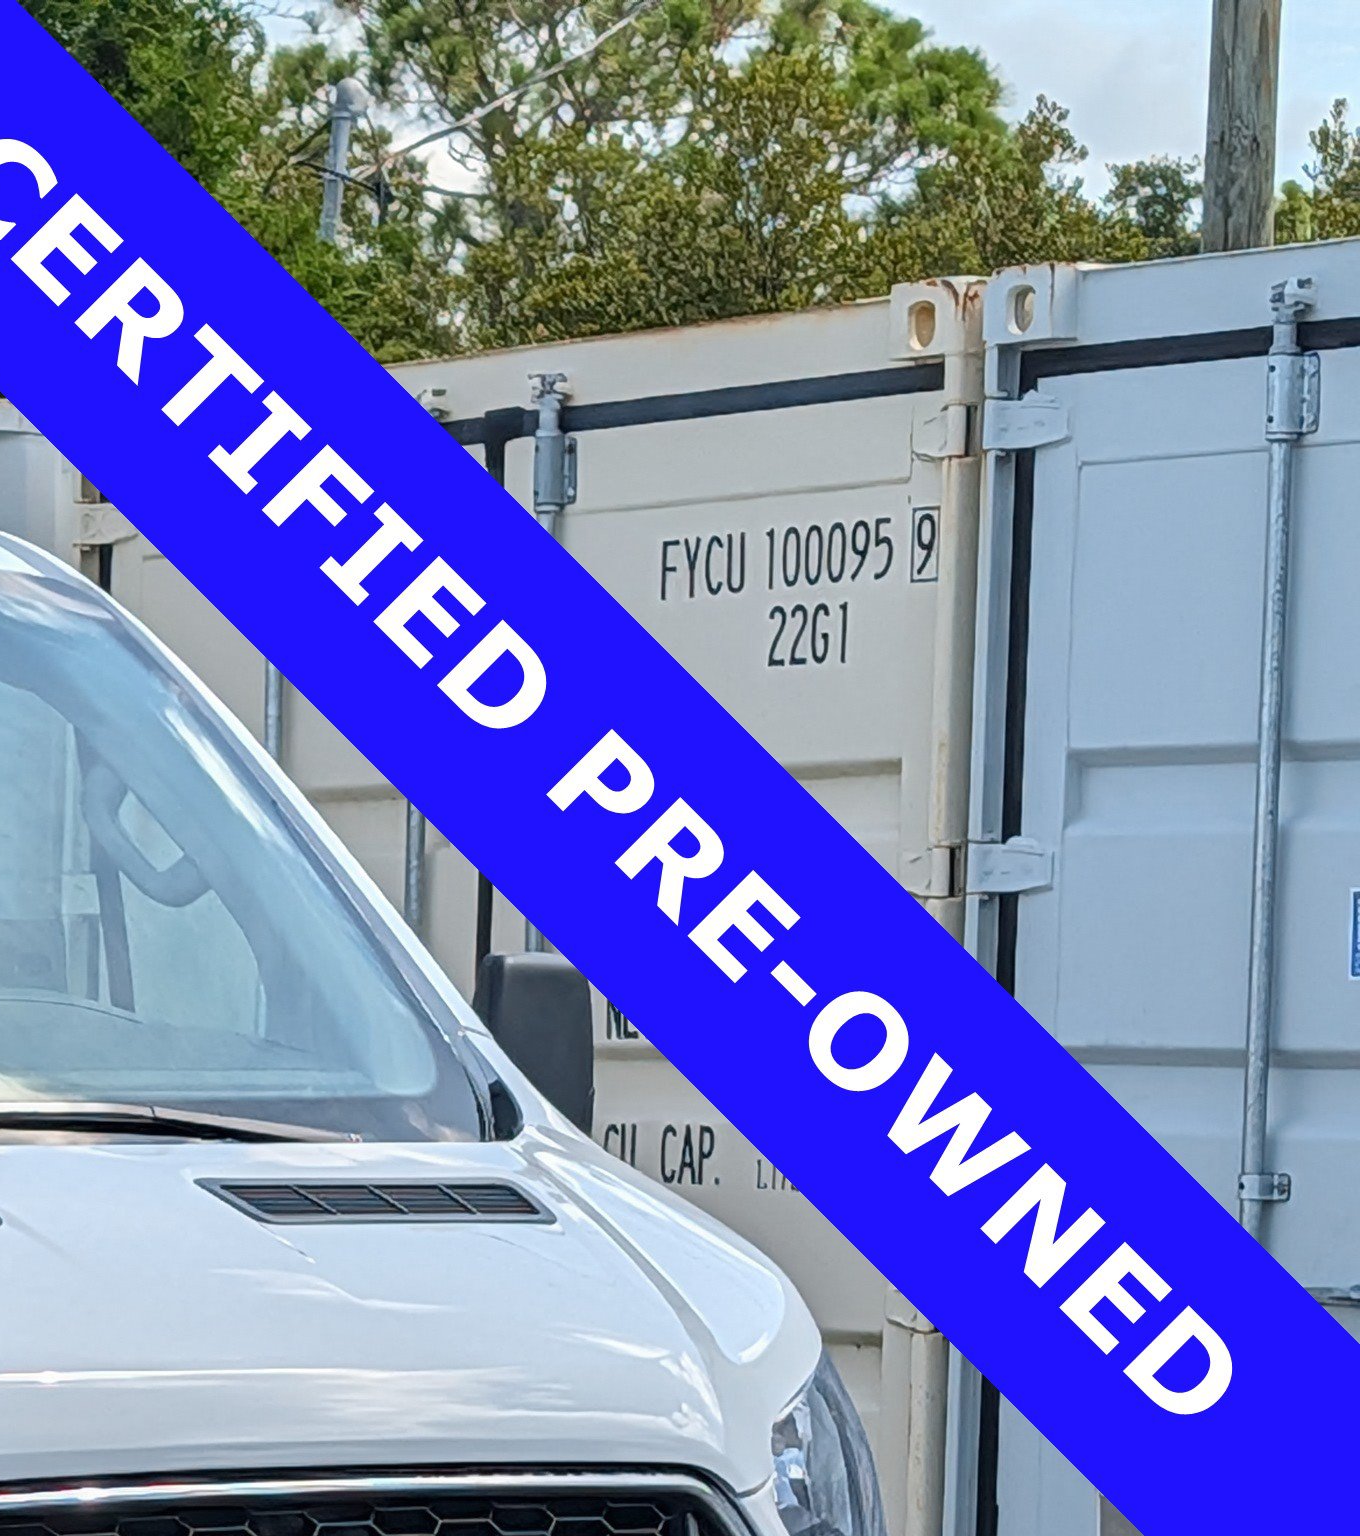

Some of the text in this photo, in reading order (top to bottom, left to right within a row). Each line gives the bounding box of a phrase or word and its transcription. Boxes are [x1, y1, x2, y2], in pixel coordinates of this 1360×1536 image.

[659, 510, 938, 601] FYCU 100095 9
[766, 601, 850, 667] 22G1
[659, 1122, 721, 1186] CAP.
